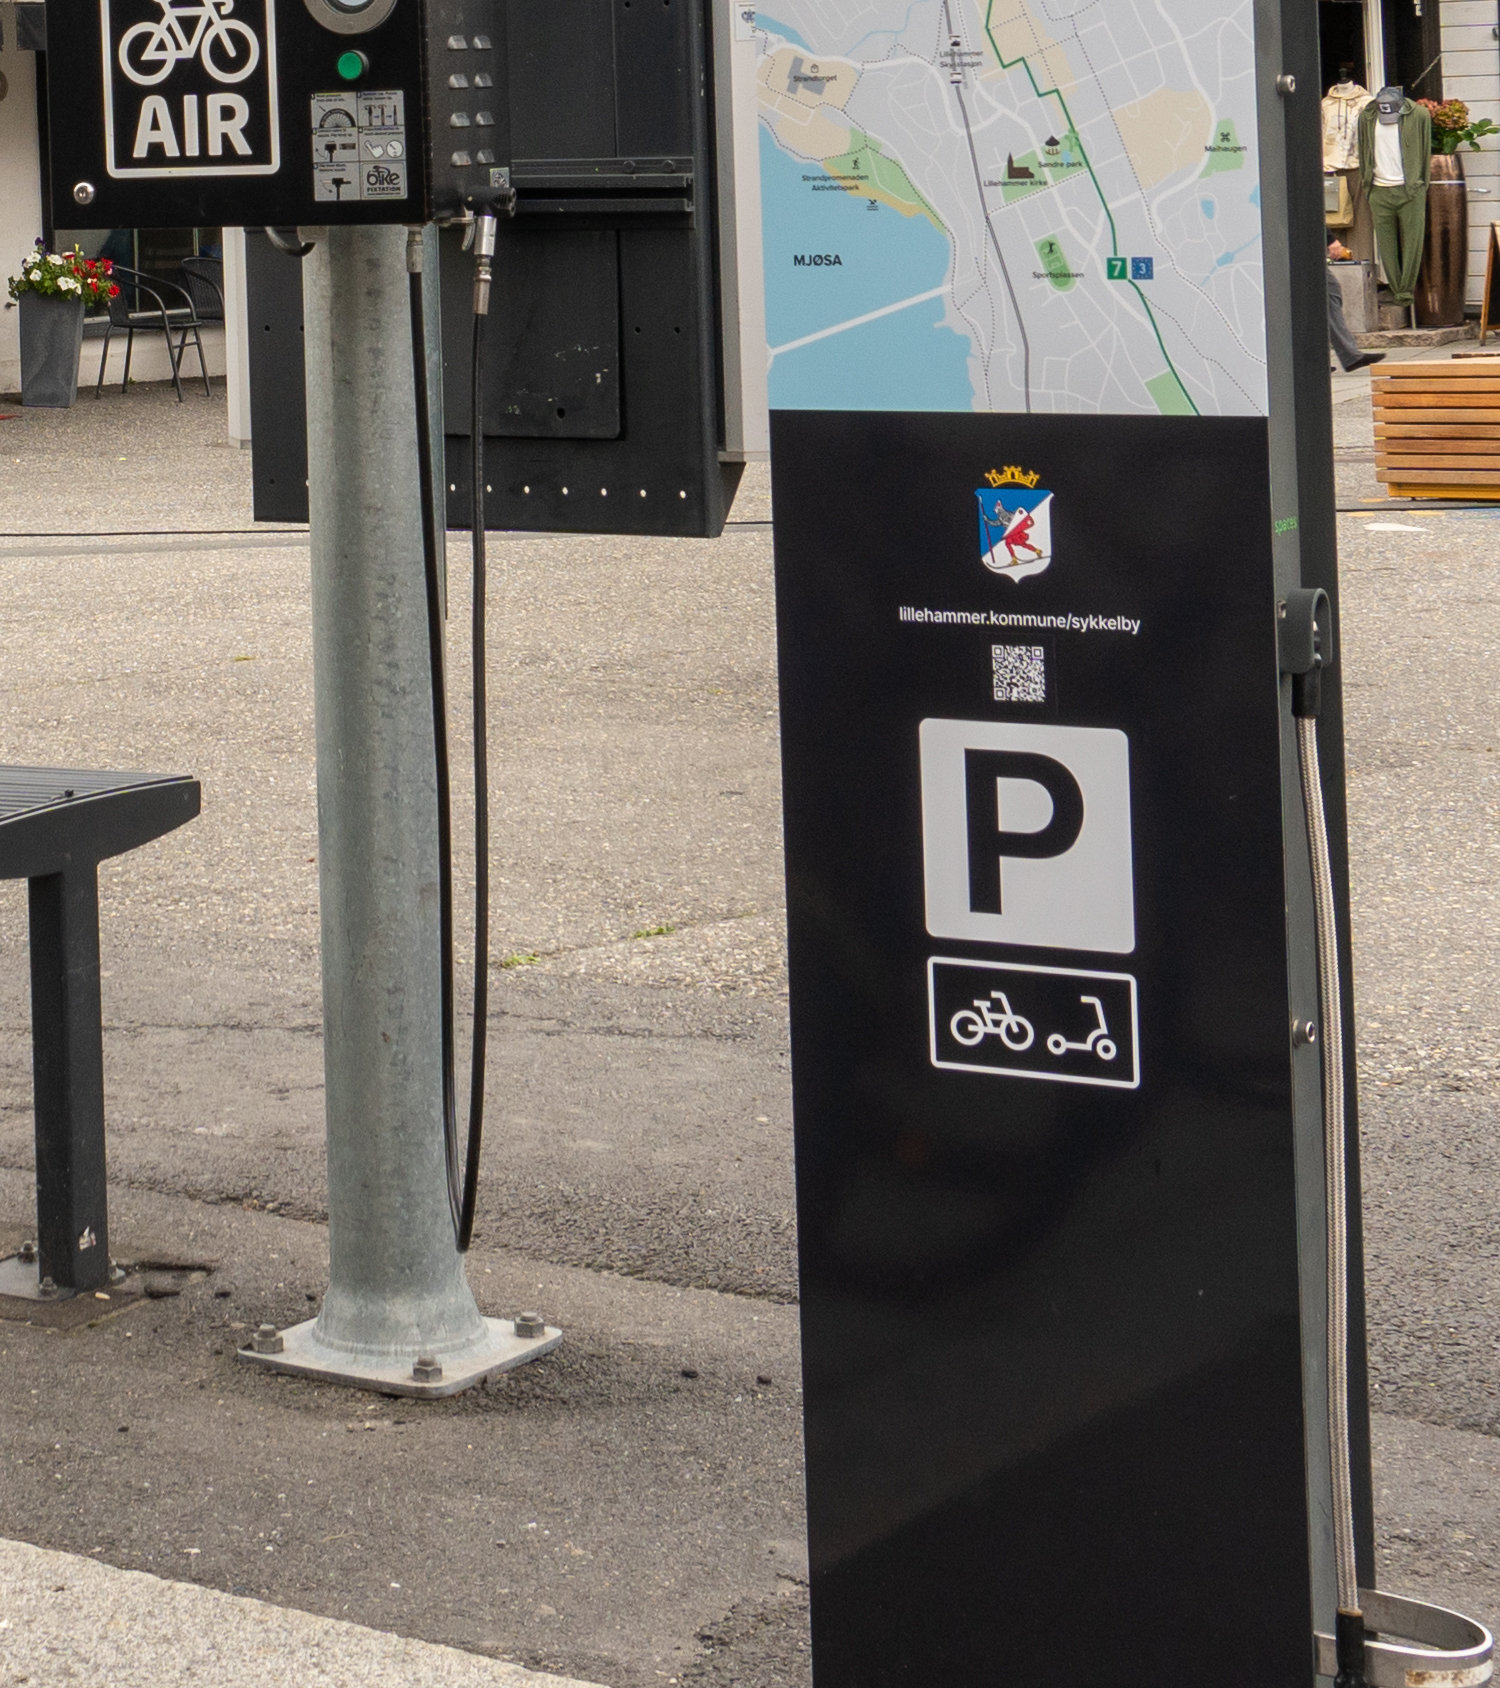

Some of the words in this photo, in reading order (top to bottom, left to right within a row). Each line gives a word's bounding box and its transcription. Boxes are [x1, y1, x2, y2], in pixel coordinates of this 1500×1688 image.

[793, 74, 837, 83] Strandtorget
[133, 92, 253, 159] AIR
[793, 254, 843, 266] MJØSA
[1111, 260, 1123, 276] 7
[899, 606, 1141, 636] lillehammer.kommune/sykkelby
[963, 747, 1085, 916] P
